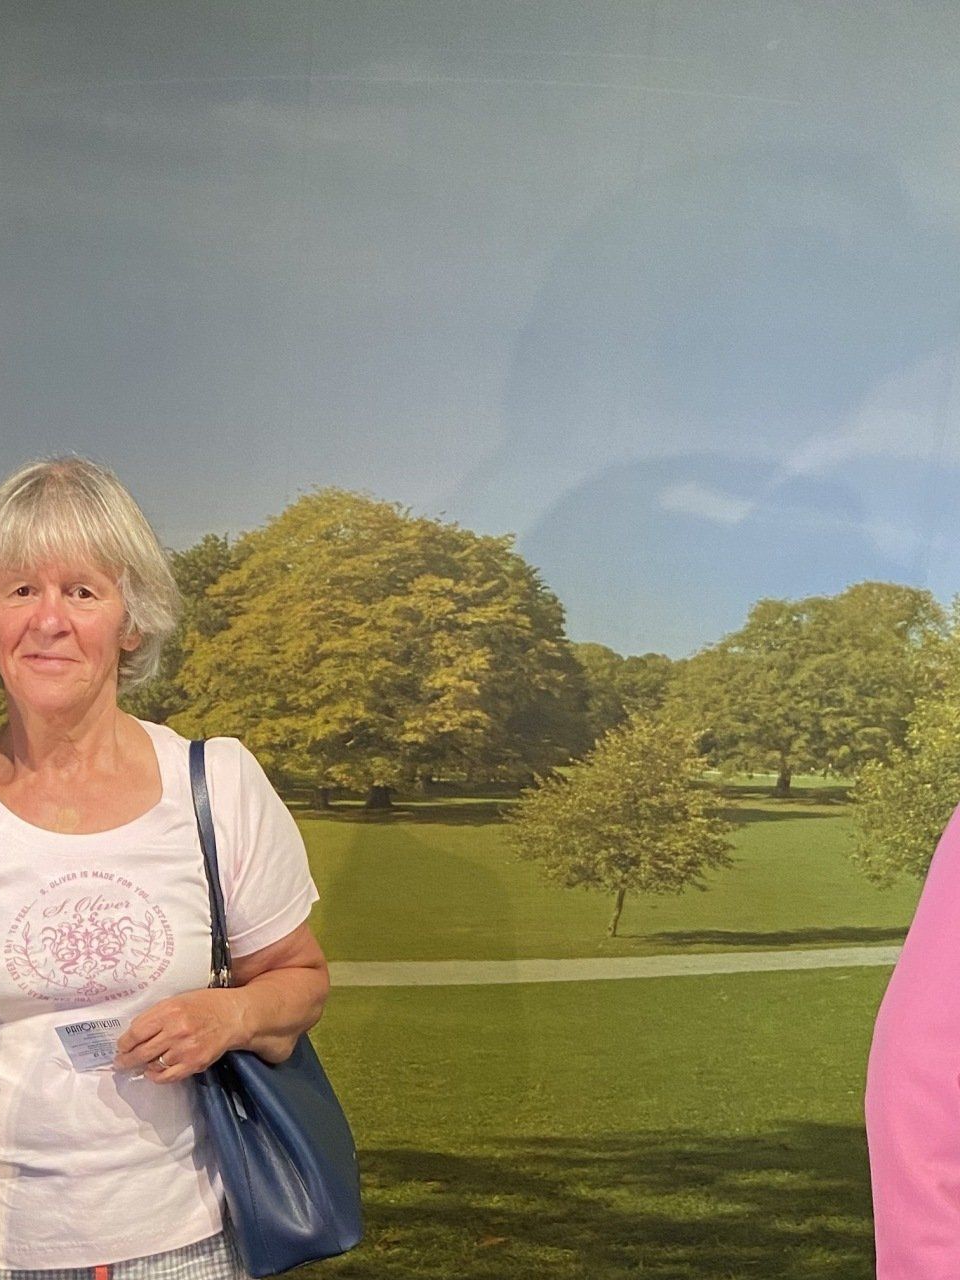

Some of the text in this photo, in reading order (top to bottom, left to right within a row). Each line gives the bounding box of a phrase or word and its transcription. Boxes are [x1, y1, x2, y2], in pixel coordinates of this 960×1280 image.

[48, 872, 78, 889] OLIVER
[81, 870, 89, 878] IS
[92, 870, 115, 881] MADE
[117, 876, 133, 888] FOR
[74, 894, 131, 912] Oliver
[7, 924, 19, 934] TO
[3, 939, 13, 954] DAY
[5, 957, 21, 981] EVERY
[148, 958, 171, 982] SINCE
[18, 982, 29, 991] IT
[104, 988, 137, 1001] YEARS
